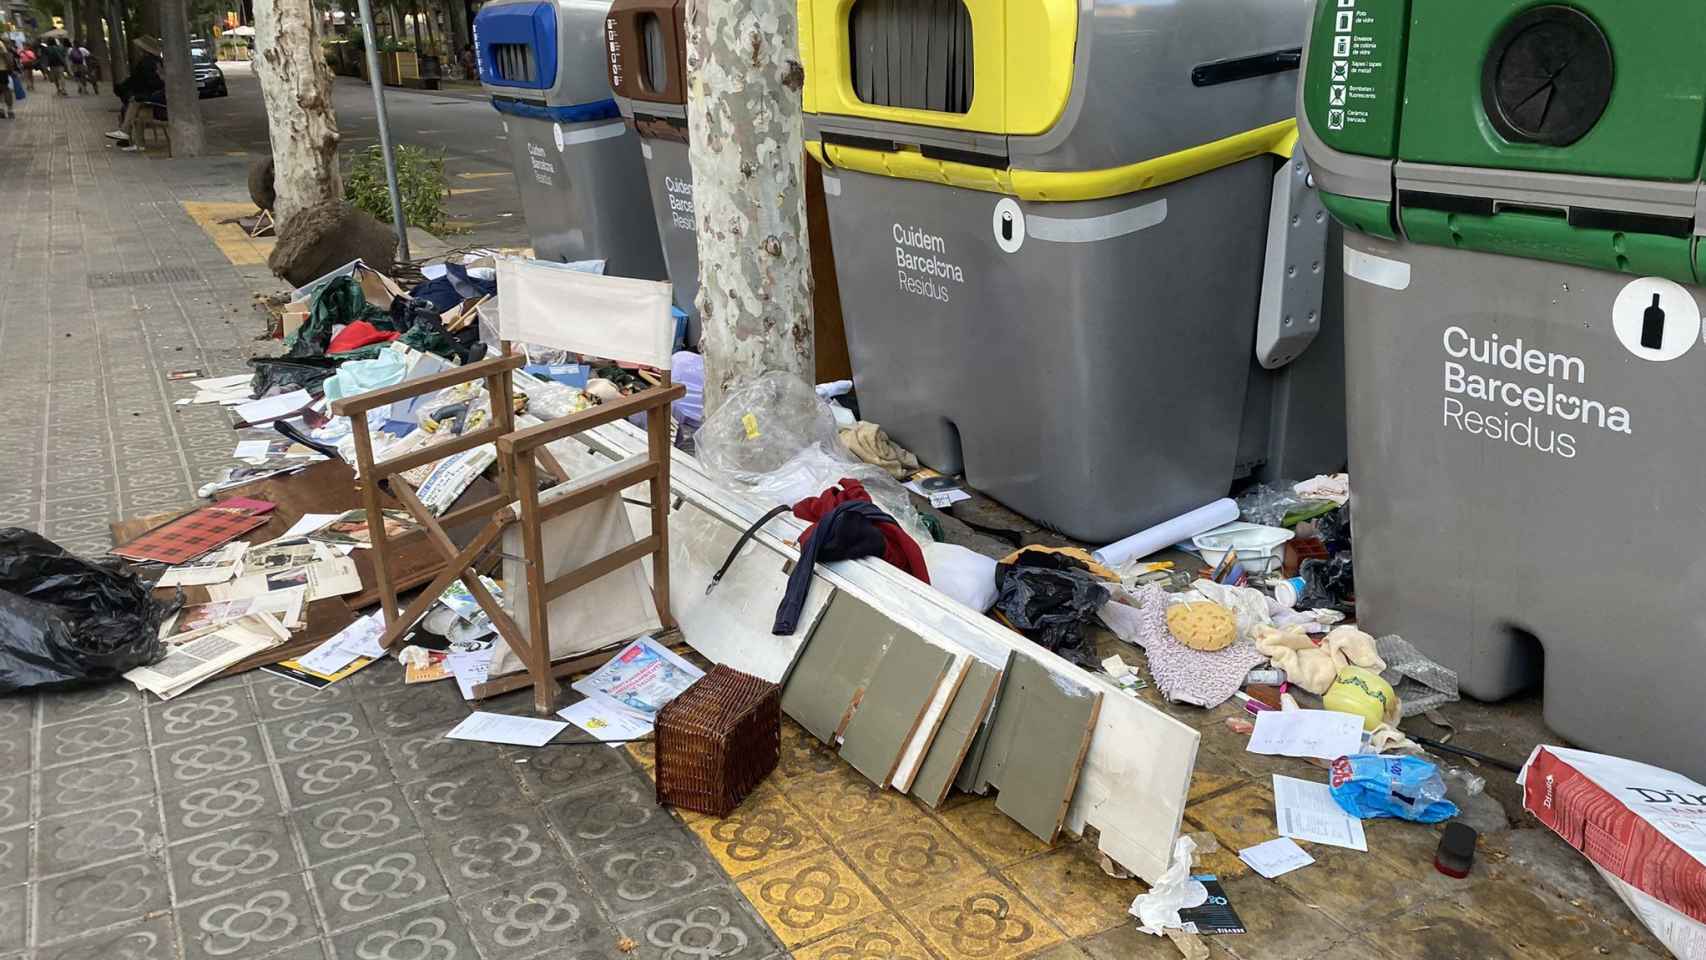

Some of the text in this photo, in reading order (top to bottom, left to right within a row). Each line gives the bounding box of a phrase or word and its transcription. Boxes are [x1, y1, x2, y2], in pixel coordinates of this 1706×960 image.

[892, 223, 946, 254] Cuidem
[895, 247, 964, 283] Barcelona
[898, 270, 950, 303] Residus
[1443, 326, 1585, 384] Cuidem
[1444, 361, 1632, 434] Barcelona
[1443, 396, 1577, 459] Residus
